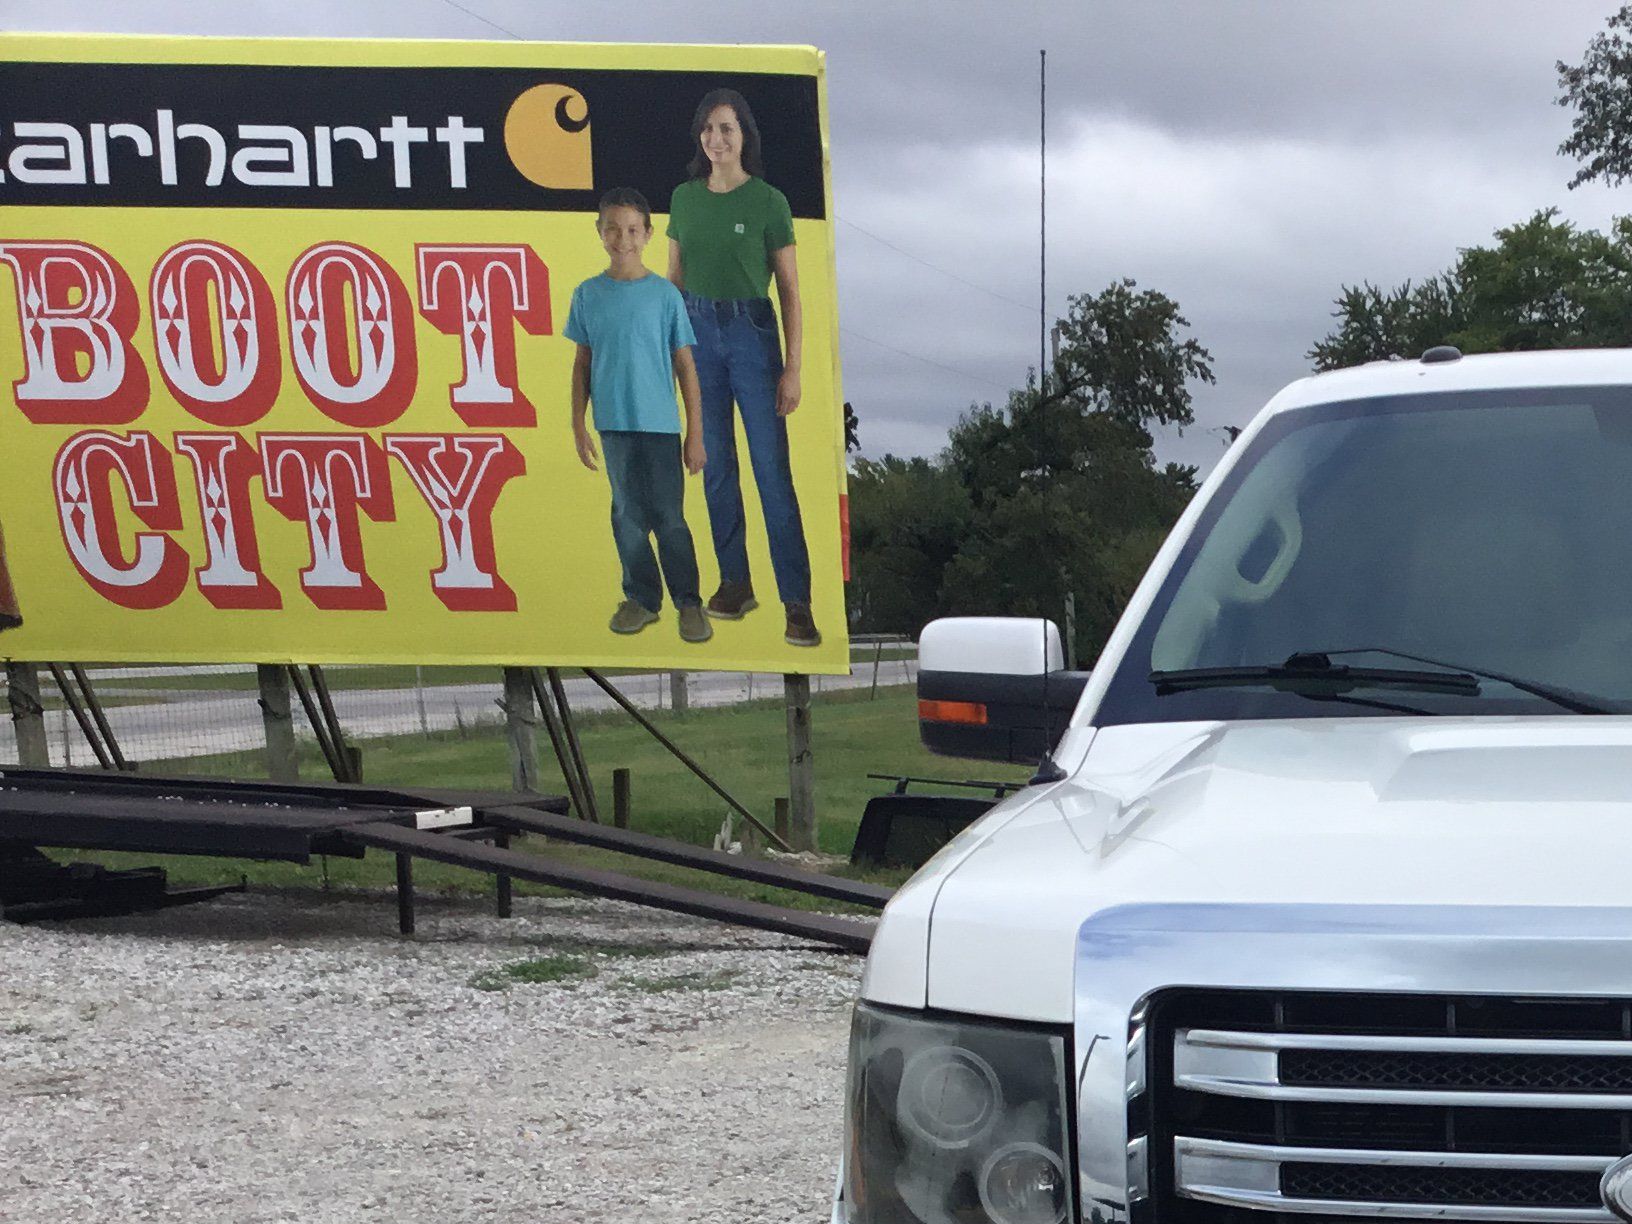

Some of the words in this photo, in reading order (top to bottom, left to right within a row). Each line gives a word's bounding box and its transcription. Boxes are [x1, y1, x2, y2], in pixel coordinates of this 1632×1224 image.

[0, 108, 484, 189] arhartt
[0, 239, 553, 427] BOOT
[52, 430, 526, 612] CITY
